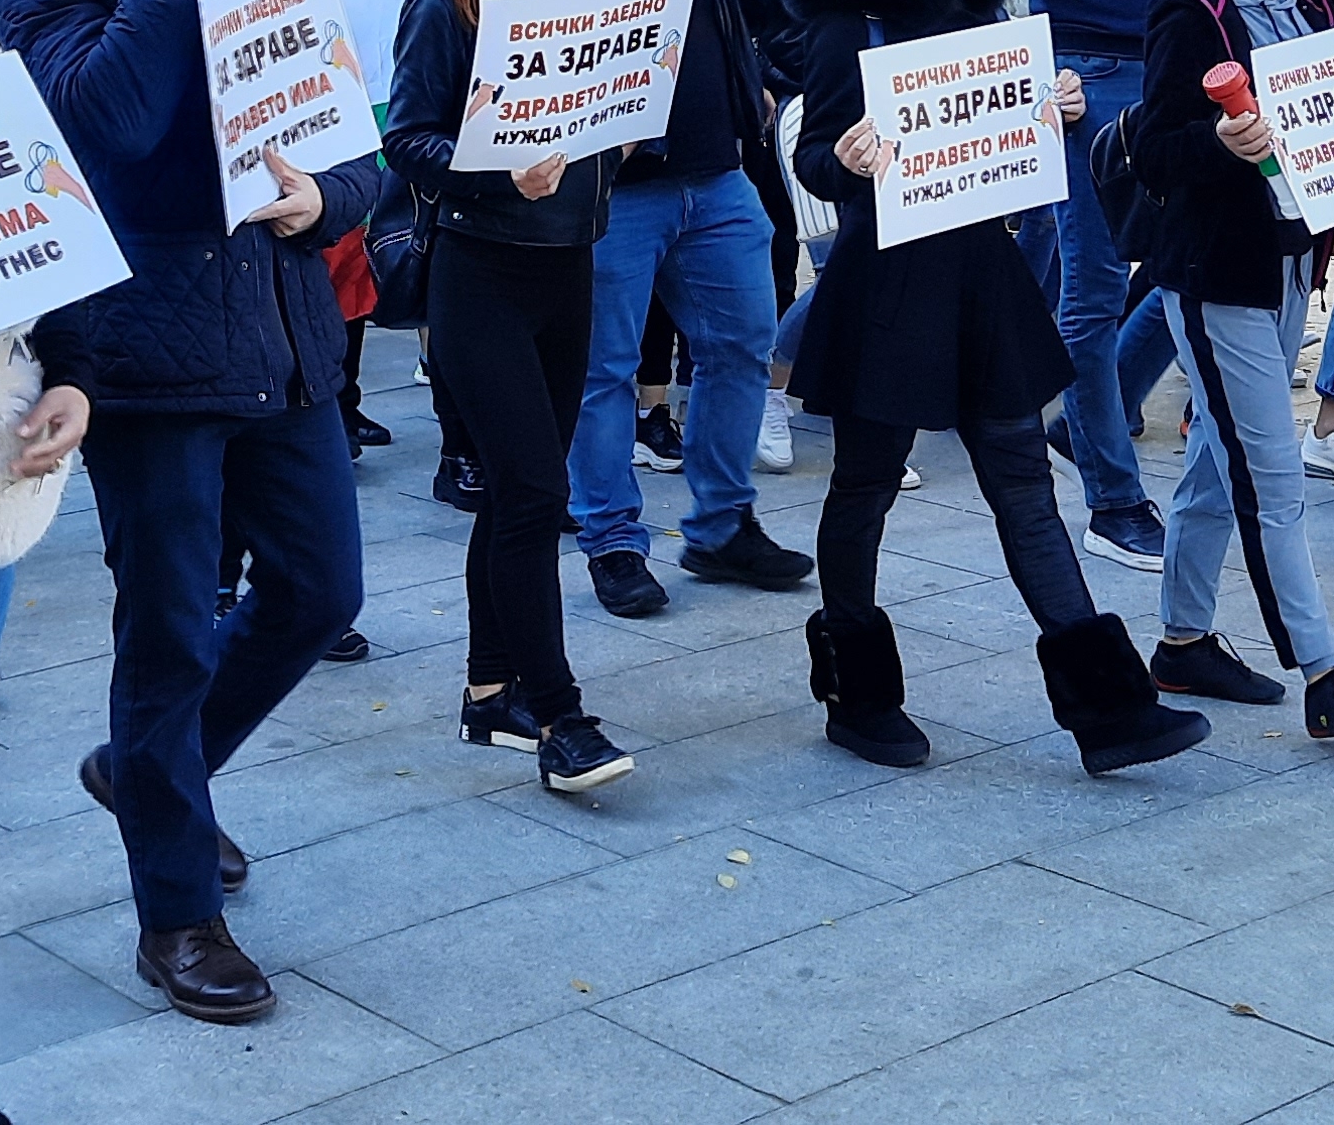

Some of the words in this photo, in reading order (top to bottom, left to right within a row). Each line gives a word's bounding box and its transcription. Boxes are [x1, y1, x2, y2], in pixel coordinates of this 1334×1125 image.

[233, 17, 320, 84] ЗДРАВЕ
[505, 51, 547, 80] ЗА
[558, 24, 661, 75] ЗДРАВЕ
[509, 14, 595, 42] ВСИЧКИ
[292, 72, 334, 107] ИМА
[892, 62, 962, 95] ВСИЧКИ
[966, 47, 1031, 78] ЗАЕДНО
[1268, 66, 1312, 94] ВСИЧКИ
[498, 82, 608, 123] ЗДРАВЕТО
[611, 69, 651, 96] ИМА
[898, 102, 933, 135] ЗА
[938, 77, 1034, 128] ЗДРАВЕ
[1277, 102, 1304, 132] ЗА
[281, 106, 341, 147] ФИТНЕС
[493, 125, 563, 146] НУЖДА
[568, 117, 588, 137] ОТ
[590, 97, 647, 127] ФИТНЕС
[901, 137, 993, 180] ЗДРАВЕТО
[998, 126, 1038, 153] ИМА
[902, 181, 954, 208] НУЖДА
[958, 174, 977, 192] ОТ
[980, 157, 1039, 186] ФИТНЕС
